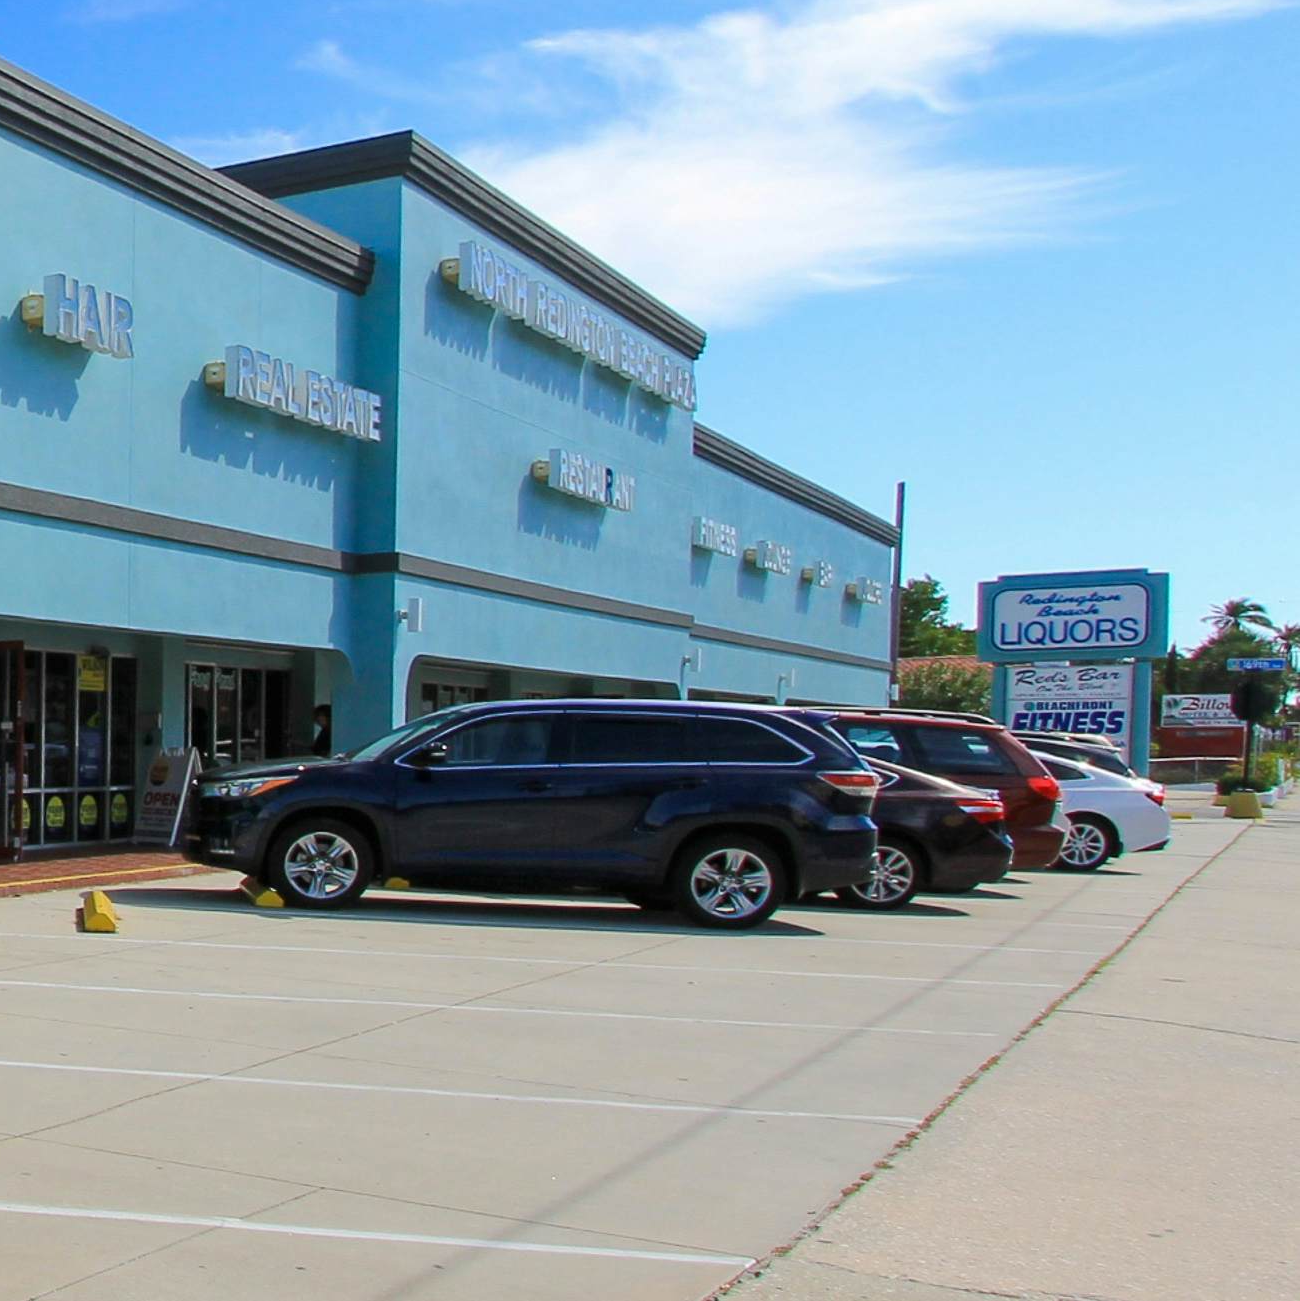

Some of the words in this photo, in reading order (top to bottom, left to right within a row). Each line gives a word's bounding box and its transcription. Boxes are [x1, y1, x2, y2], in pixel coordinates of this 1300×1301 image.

[44, 273, 134, 359] HAIR
[459, 240, 527, 320] NORTH
[526, 280, 614, 369] REDINGTON
[225, 345, 299, 418] REAL
[299, 369, 382, 442] ESTATE
[549, 449, 635, 511] RESTAURANT
[1019, 591, 1123, 606] Redington
[1037, 603, 1100, 617] Beach
[1000, 617, 1140, 645] LIQUORS
[1015, 669, 1067, 685] Red's
[1076, 667, 1121, 681] Bar
[1036, 701, 1113, 710] BEACHFRONT
[1012, 711, 1125, 734] FITNESS
